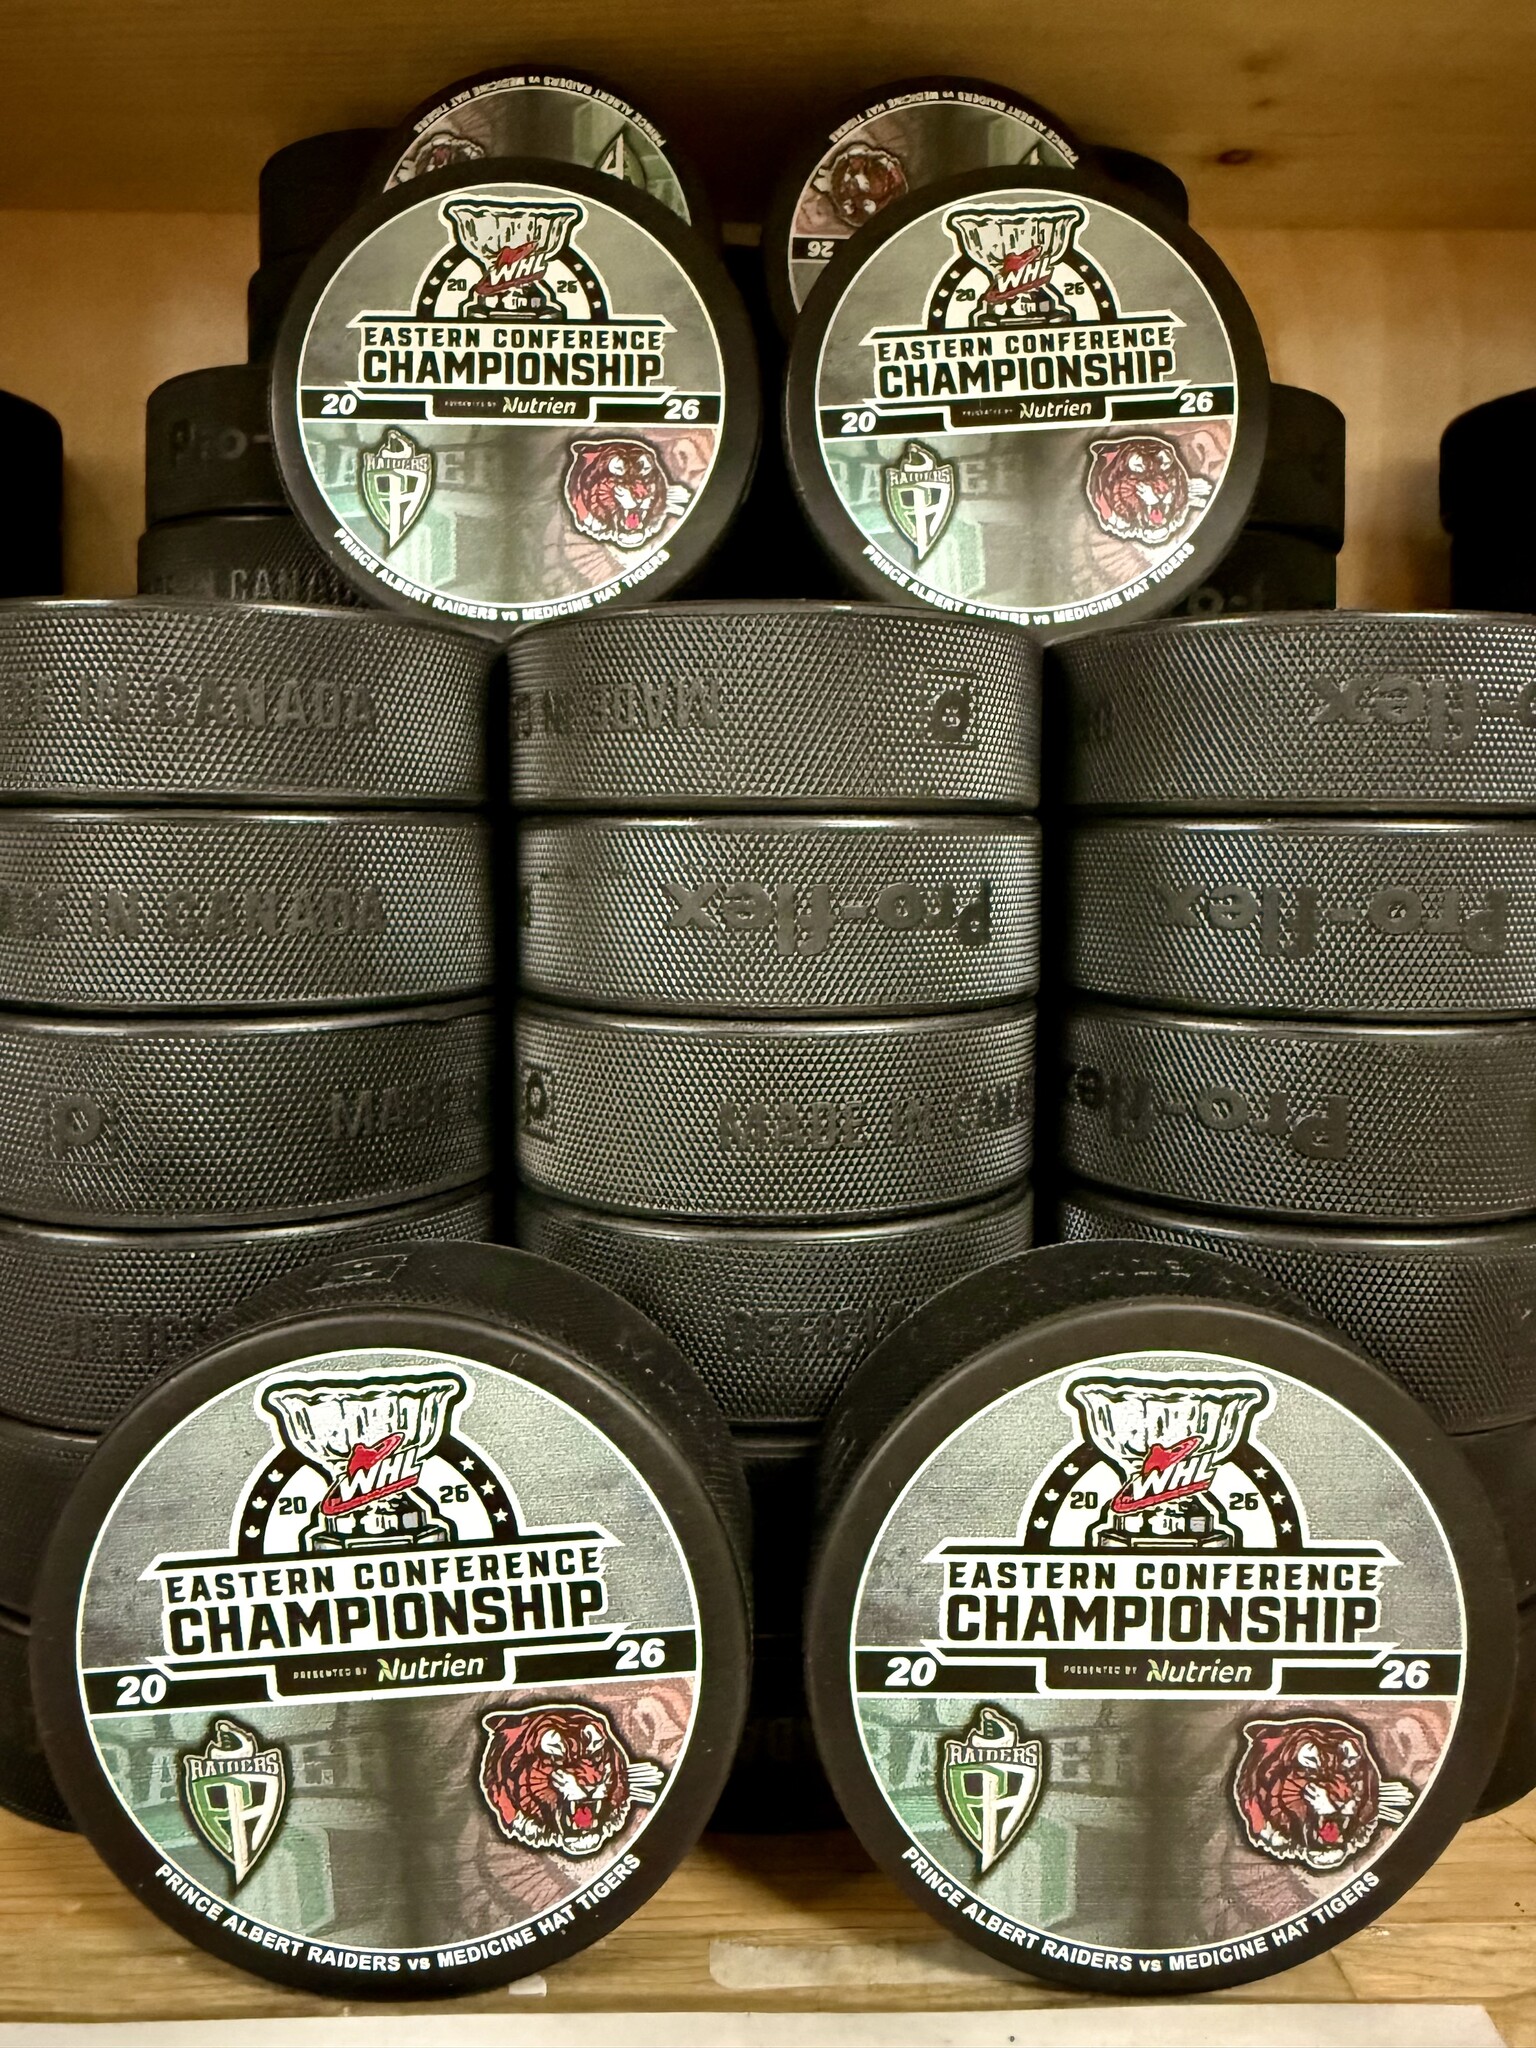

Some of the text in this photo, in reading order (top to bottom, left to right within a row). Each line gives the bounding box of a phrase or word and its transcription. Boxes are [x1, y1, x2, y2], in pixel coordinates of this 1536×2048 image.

[807, 240, 835, 258] 26
[490, 253, 549, 285] WHL
[998, 257, 1055, 292] WHL
[447, 278, 467, 292] 20
[557, 280, 578, 293] 26
[956, 288, 976, 302] 20
[1064, 282, 1085, 295] 26
[364, 326, 662, 351] EASTERN CONFERENCE
[878, 326, 1171, 362] EASTERN CONFERENCE
[363, 350, 662, 387] CHAMPIONSHIP
[878, 350, 1174, 399] CHAMPIONSHIP
[320, 393, 357, 415] 20
[502, 396, 577, 415] Nutrien
[664, 398, 700, 420] 26
[1019, 399, 1092, 419] Nutrien
[1179, 392, 1214, 414] 26
[840, 412, 876, 434] 20
[334, 528, 379, 573] PRINCE
[376, 568, 431, 604] ALBERT
[433, 597, 497, 621] RAIDERS
[522, 594, 593, 621] MEDICINE
[594, 582, 621, 604] HAT
[622, 549, 670, 588] TIGERS
[862, 544, 909, 588] PRINCE
[907, 582, 964, 617] ALBERT
[965, 604, 1030, 626] RAIDERS
[1053, 596, 1123, 624] MEDICINE
[1123, 578, 1150, 602] HAT
[1150, 542, 1195, 584] TIGERS
[660, 880, 993, 956] Pro-flex
[1157, 884, 1506, 956] Pro-flex
[1067, 1066, 1351, 1160] Pro-fle
[339, 1445, 425, 1502] WHL
[1132, 1451, 1218, 1502] WHL
[278, 1496, 307, 1515] 20
[439, 1484, 469, 1503] 26
[1070, 1491, 1098, 1510] 20
[1229, 1492, 1259, 1511] 26
[166, 1546, 600, 1604] EASTERN CONFERENCE
[949, 1561, 1378, 1591] EASTERN CONFERENCE
[167, 1580, 603, 1656] CHAMPIONSHIP
[946, 1595, 1377, 1643] CHAMPIONSHIP
[377, 1653, 484, 1682] Nutrien
[615, 1638, 666, 1670] 26
[885, 1656, 937, 1687] 20
[1146, 1658, 1252, 1683] Nutrien
[1379, 1660, 1430, 1689] 26
[116, 1674, 168, 1706] 20
[192, 1753, 279, 1781] RAIDERS
[949, 1744, 1038, 1767] RAIDERS
[155, 1853, 641, 1972] PRINCE ALBERT RAIDERS vs MEDICINE HAT TIGERS
[902, 1846, 1380, 1972] PRINCE ALBERT RAIDERS vs MEDICINE HAT TIGERS
